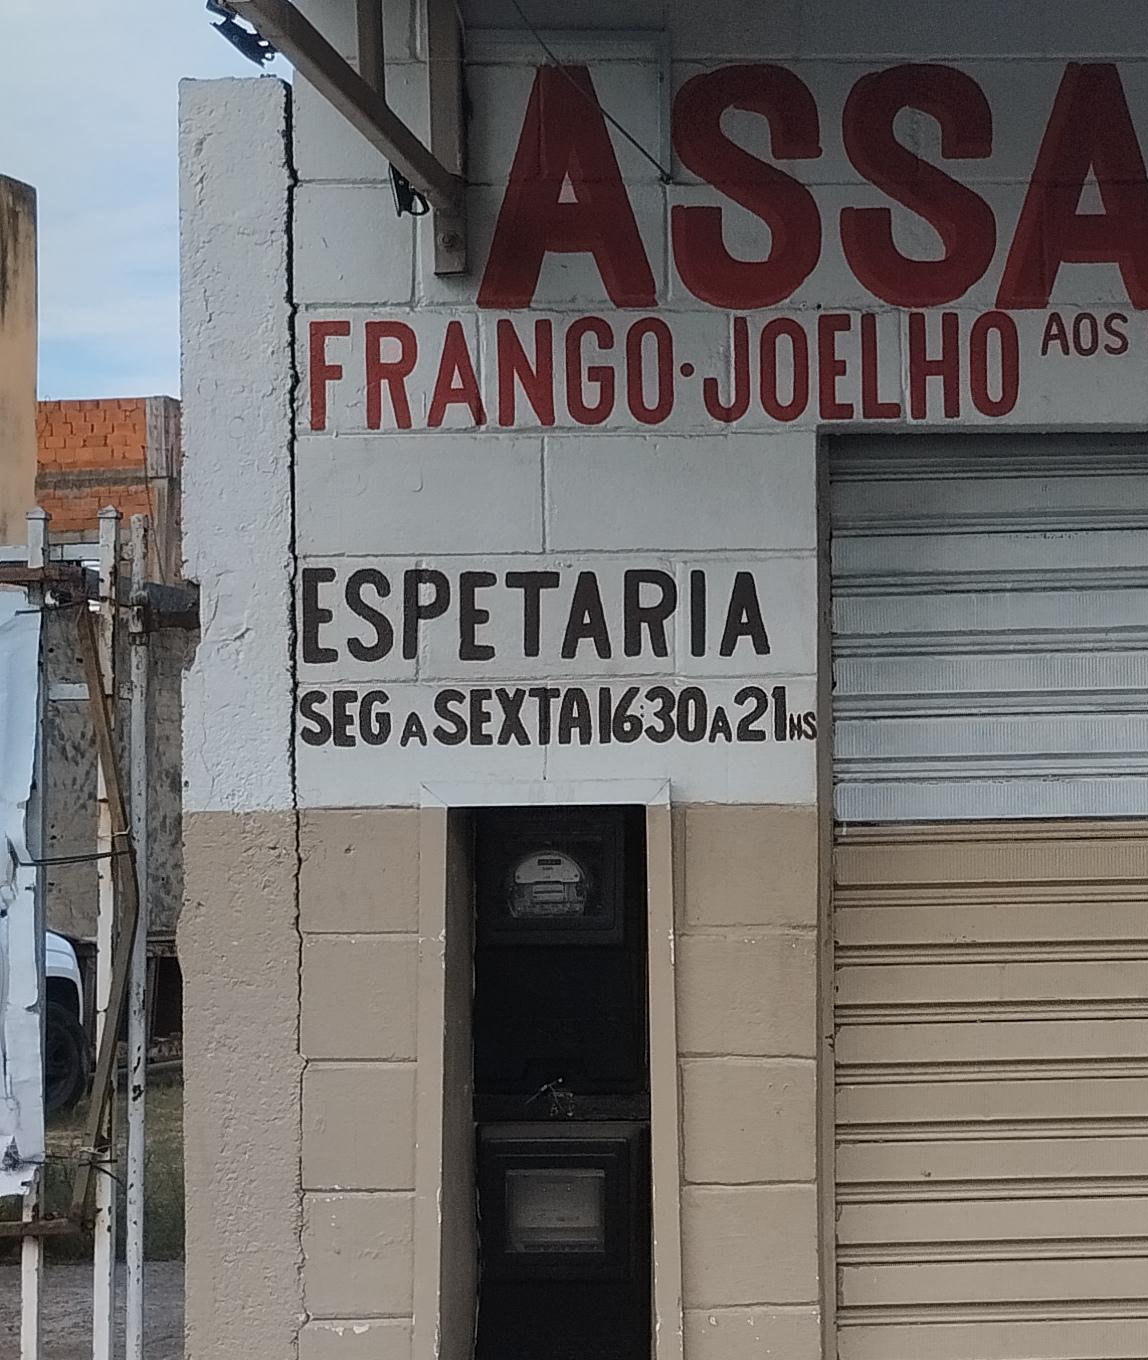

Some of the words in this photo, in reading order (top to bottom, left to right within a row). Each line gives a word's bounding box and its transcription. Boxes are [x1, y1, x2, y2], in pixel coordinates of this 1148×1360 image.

[1041, 310, 1129, 357] AOS
[301, 567, 771, 664] ESPETARIA
[299, 687, 391, 747] SEG
[432, 687, 592, 747] SEXTA
